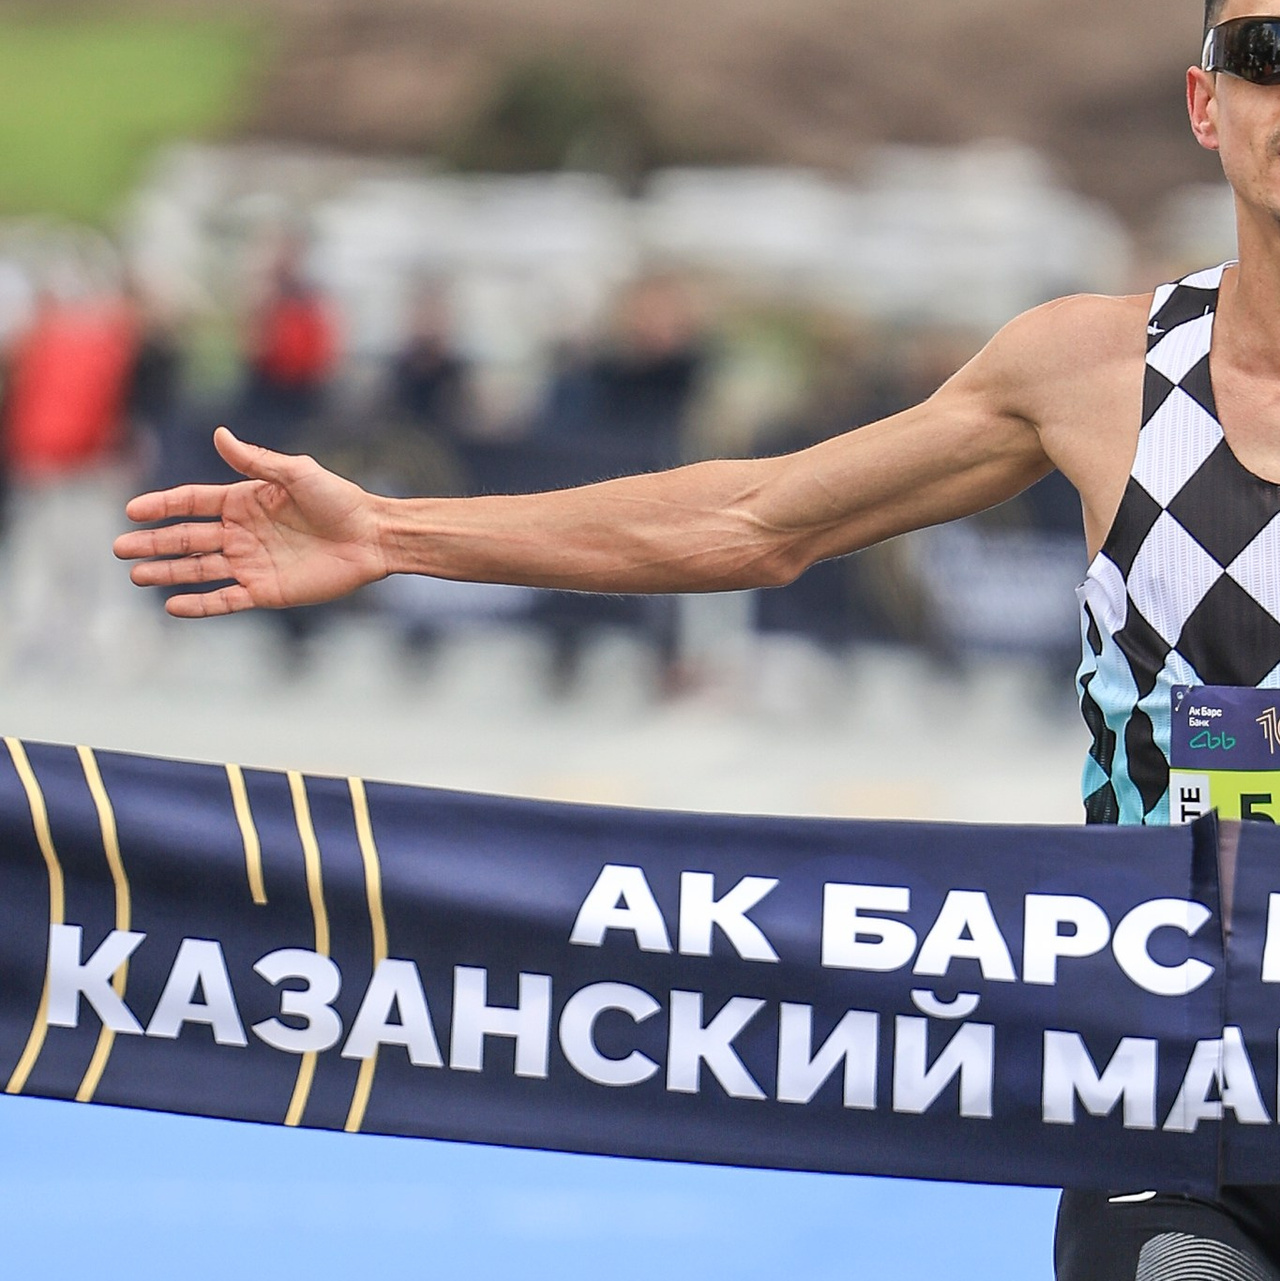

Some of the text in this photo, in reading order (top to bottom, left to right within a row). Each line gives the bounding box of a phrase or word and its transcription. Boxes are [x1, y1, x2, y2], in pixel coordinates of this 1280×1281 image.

[1188, 706, 1222, 718] Ак Барс
[1188, 717, 1210, 727] Банк
[569, 863, 781, 963] АК
[820, 882, 1216, 997] БАРС
[44, 921, 996, 1119] КАЗАНСКИЙ
